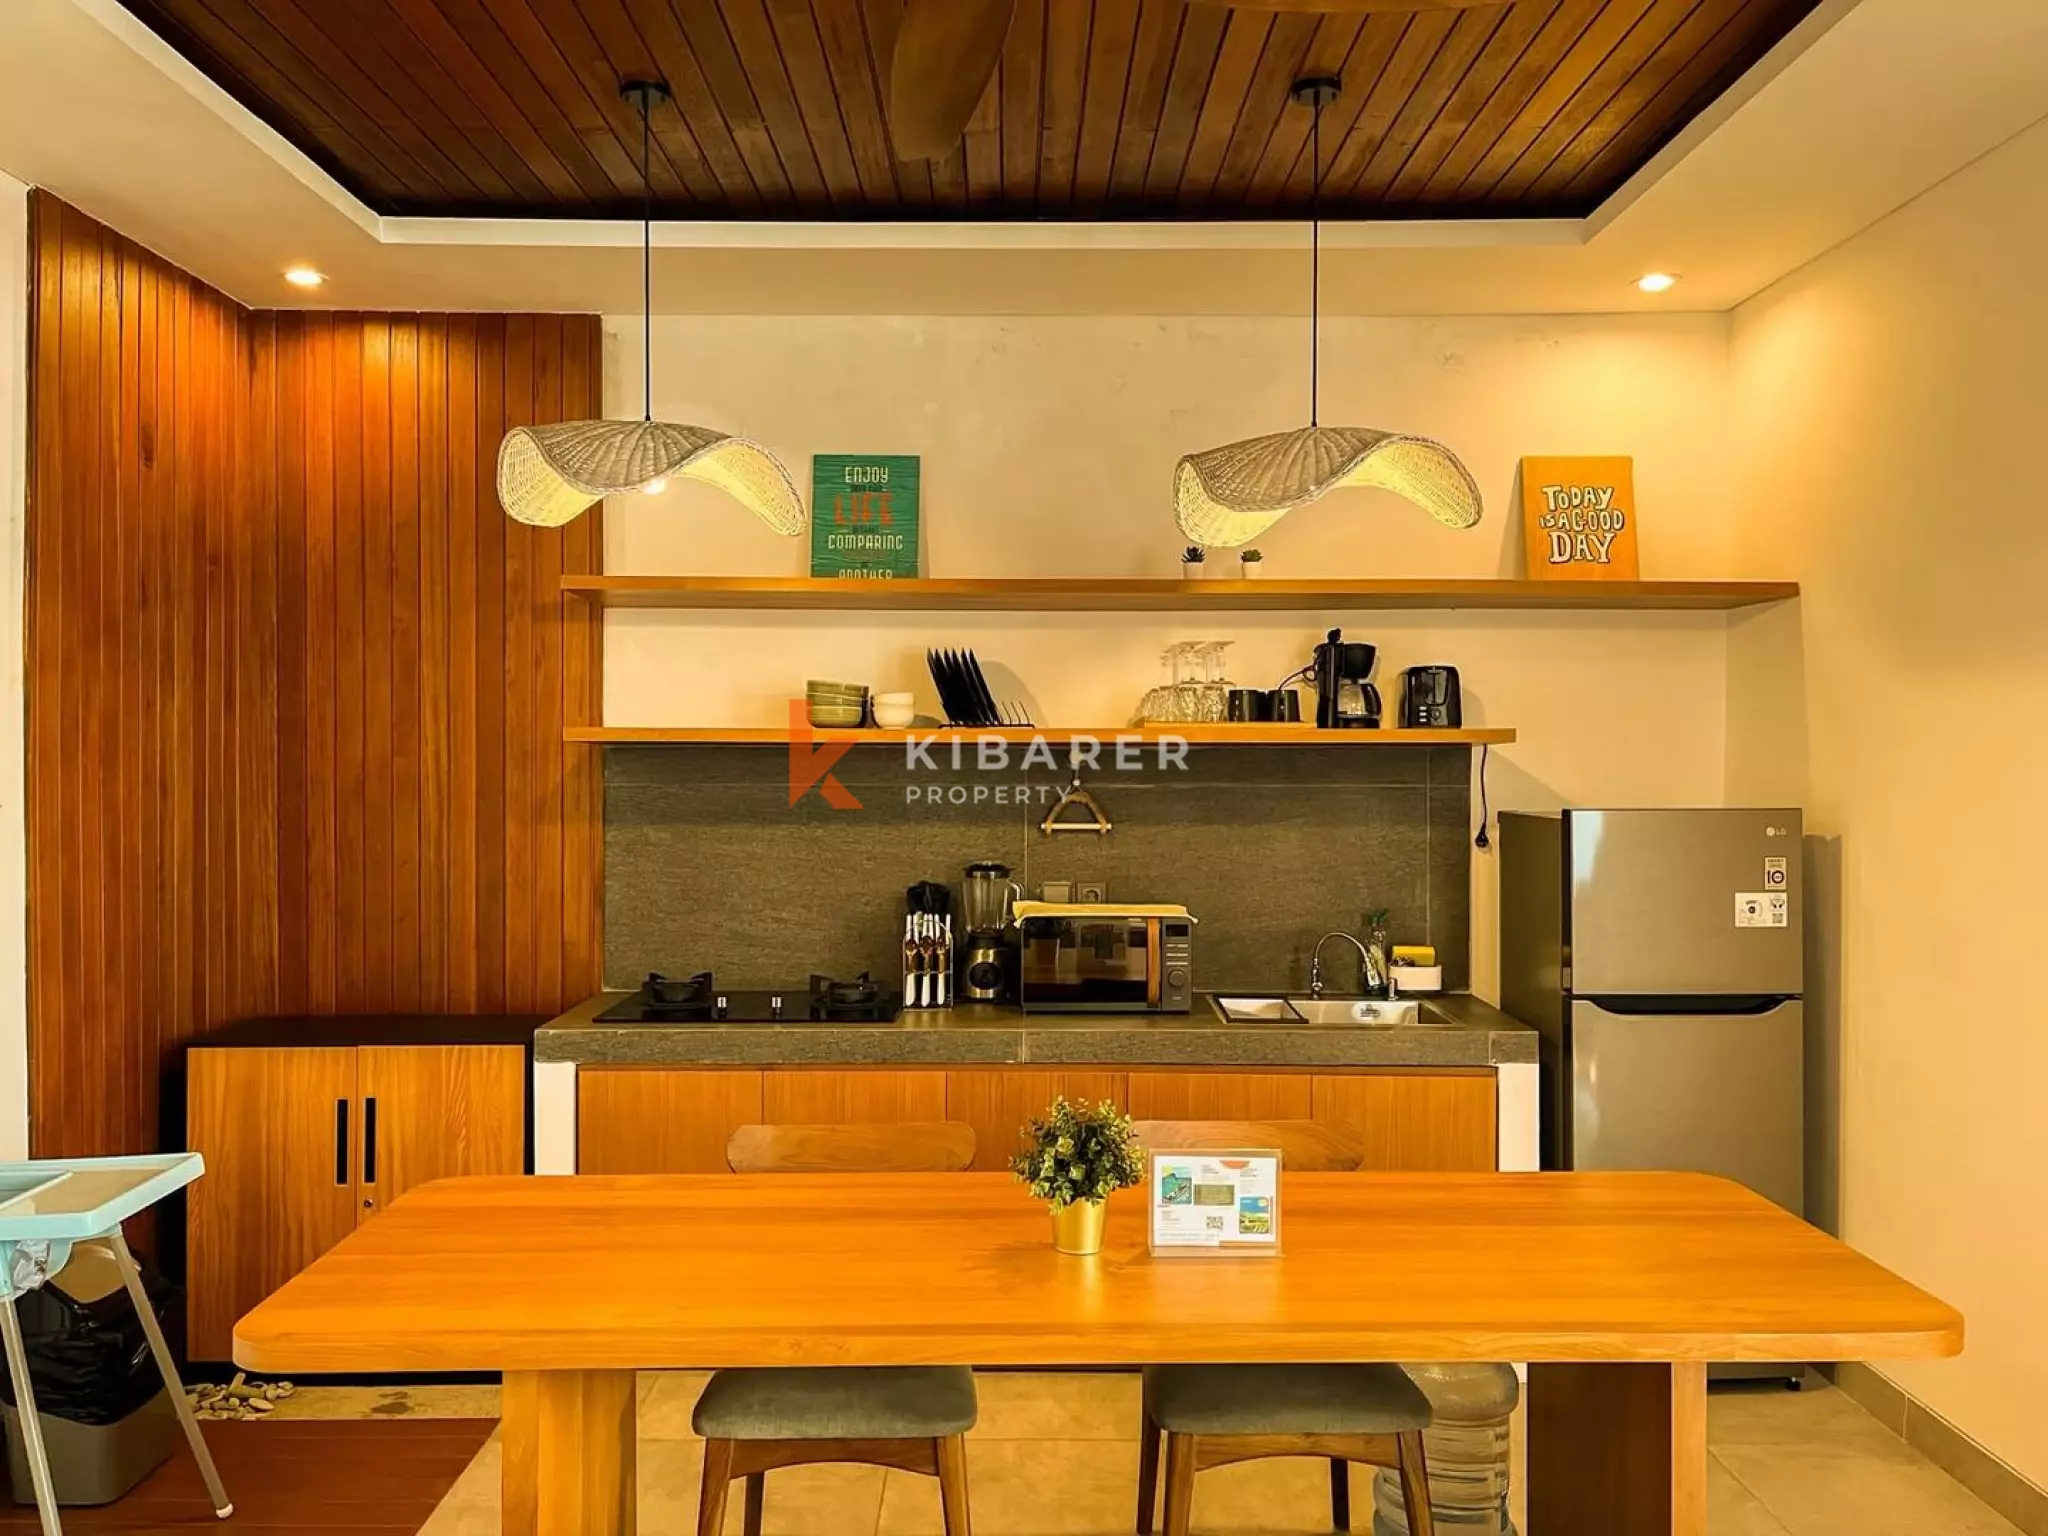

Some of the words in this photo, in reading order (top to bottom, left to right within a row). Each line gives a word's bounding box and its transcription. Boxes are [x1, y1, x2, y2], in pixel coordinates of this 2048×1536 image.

[845, 466, 889, 483] ENJOY
[833, 492, 895, 525] LIFE
[1541, 485, 1614, 511] TODAY
[1558, 511, 1571, 531] A
[1571, 509, 1625, 532] GOOD
[828, 534, 904, 550] COMPARING
[1548, 531, 1616, 563] DAY
